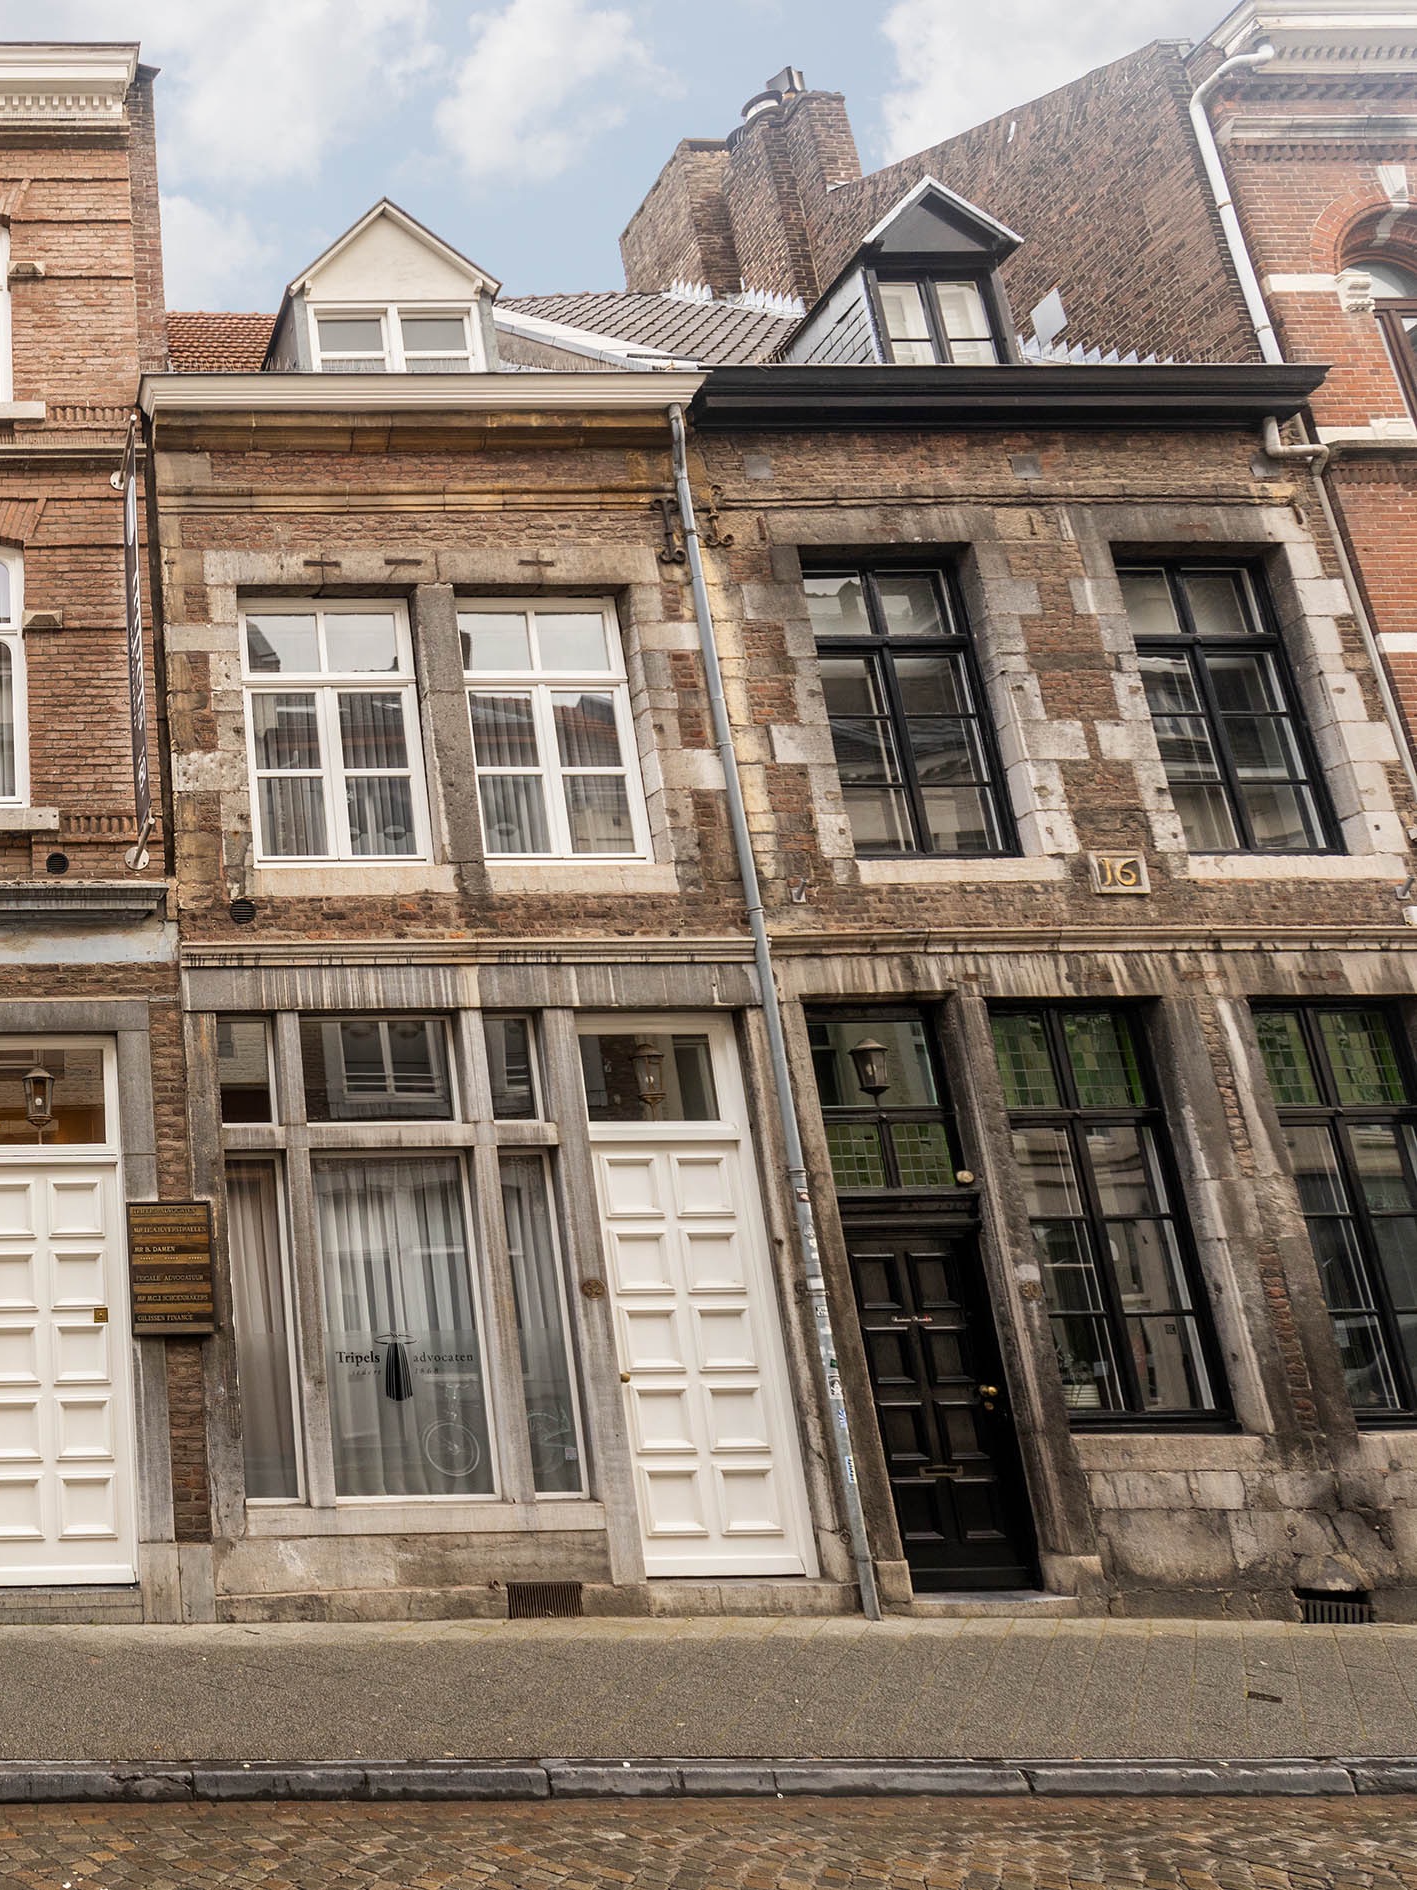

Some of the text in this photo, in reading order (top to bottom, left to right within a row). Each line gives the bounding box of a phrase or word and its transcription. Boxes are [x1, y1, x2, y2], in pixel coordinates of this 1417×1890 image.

[1101, 858, 1137, 886] 16
[336, 1351, 474, 1367] Tripels advocaten
